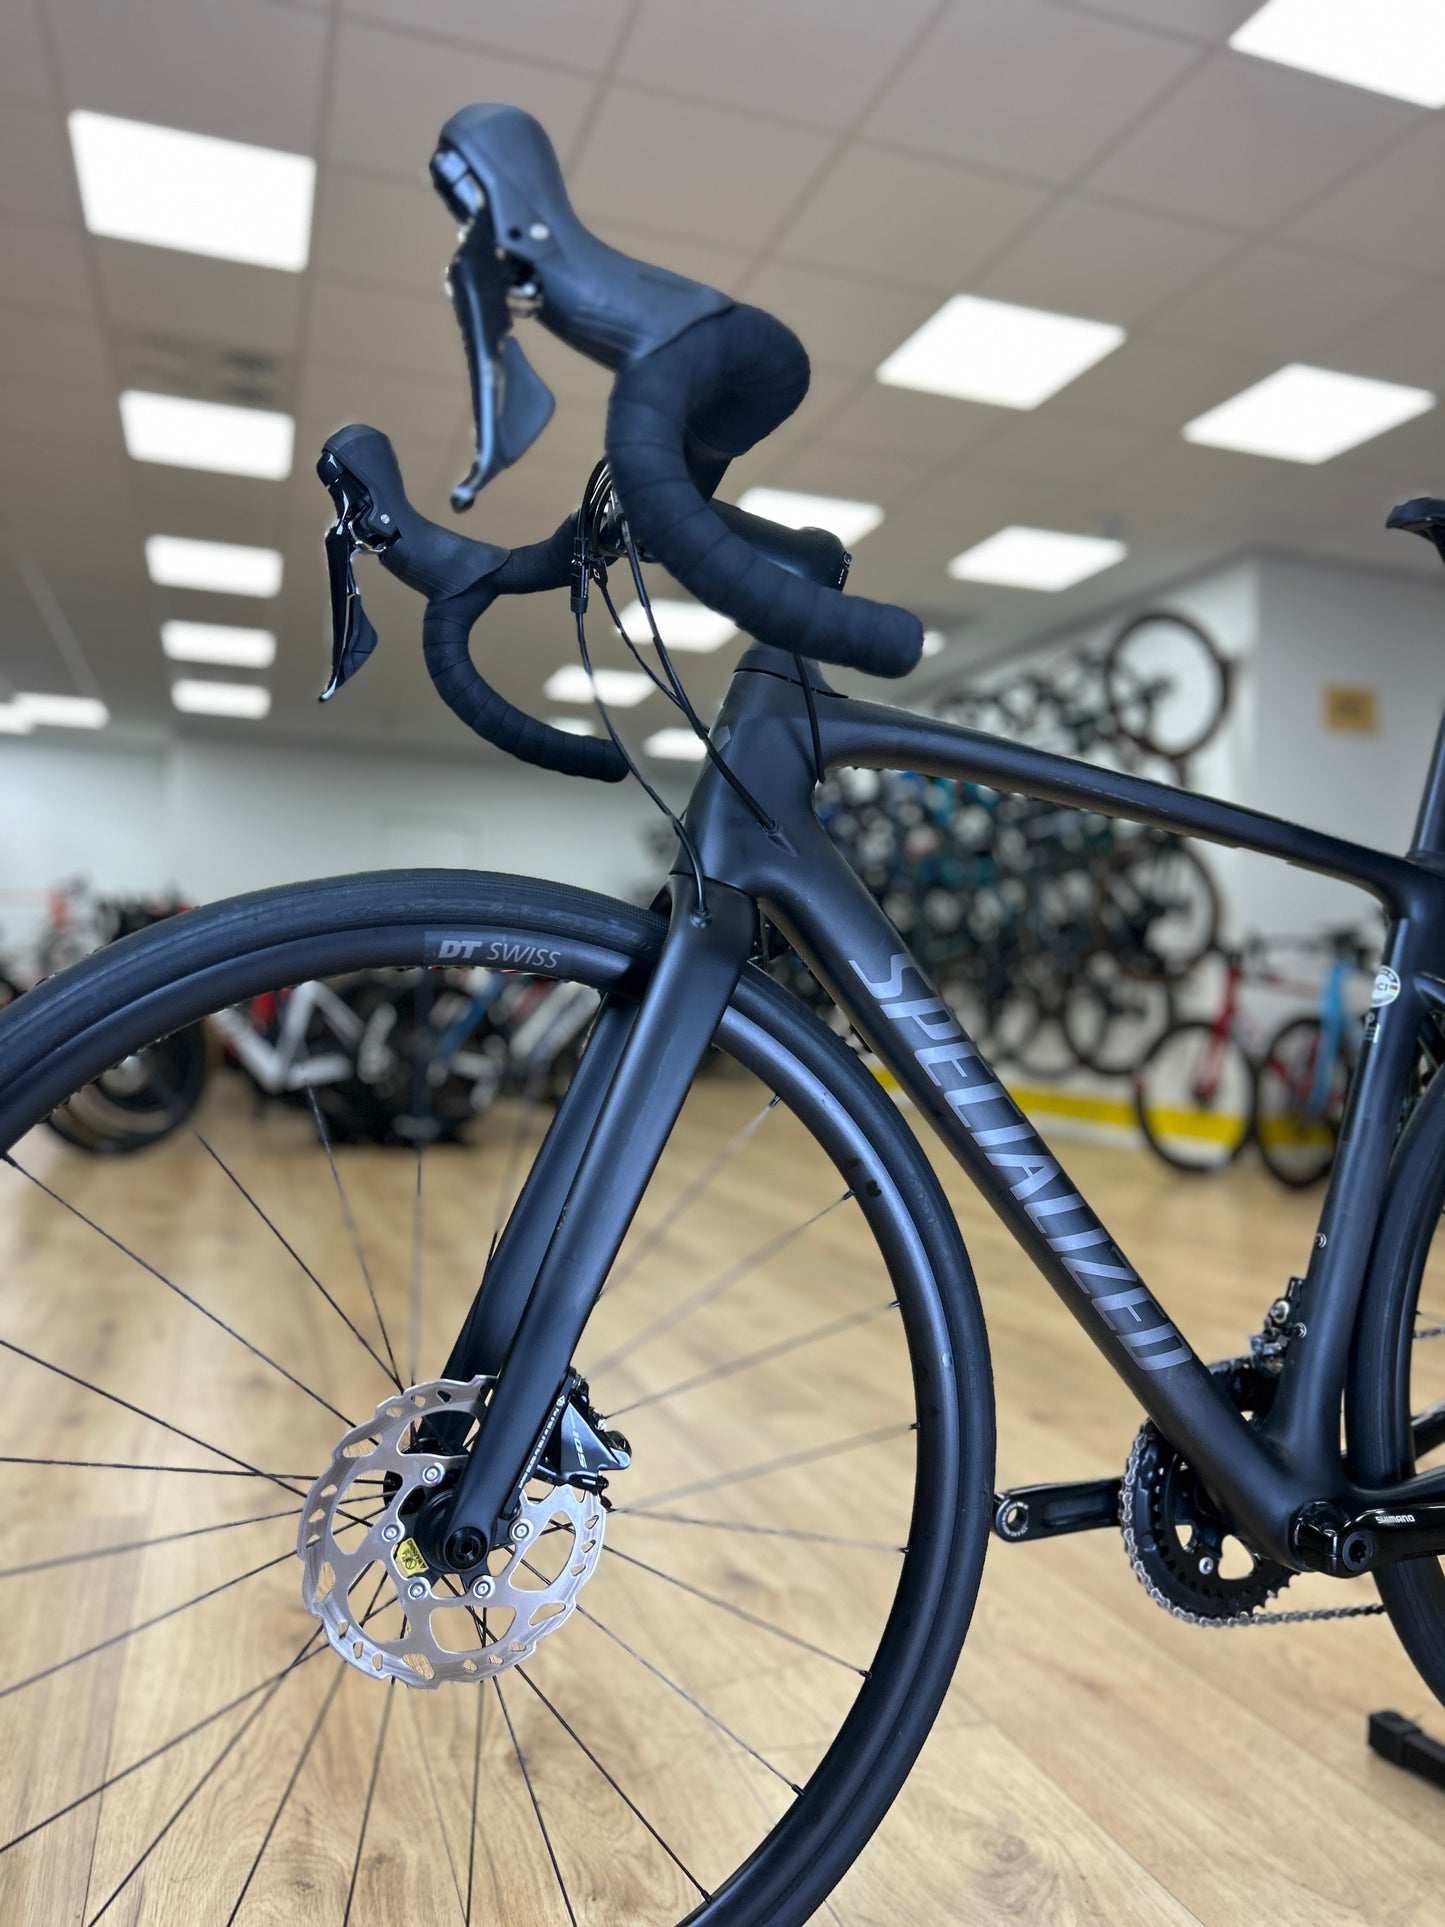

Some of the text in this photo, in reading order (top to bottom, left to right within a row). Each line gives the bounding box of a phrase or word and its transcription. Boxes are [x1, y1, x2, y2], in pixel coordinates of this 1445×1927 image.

[439, 940, 561, 969] DT SWISS
[848, 953, 1193, 1371] SPECIALIZED
[1375, 1514, 1416, 1524] SHIMANO
